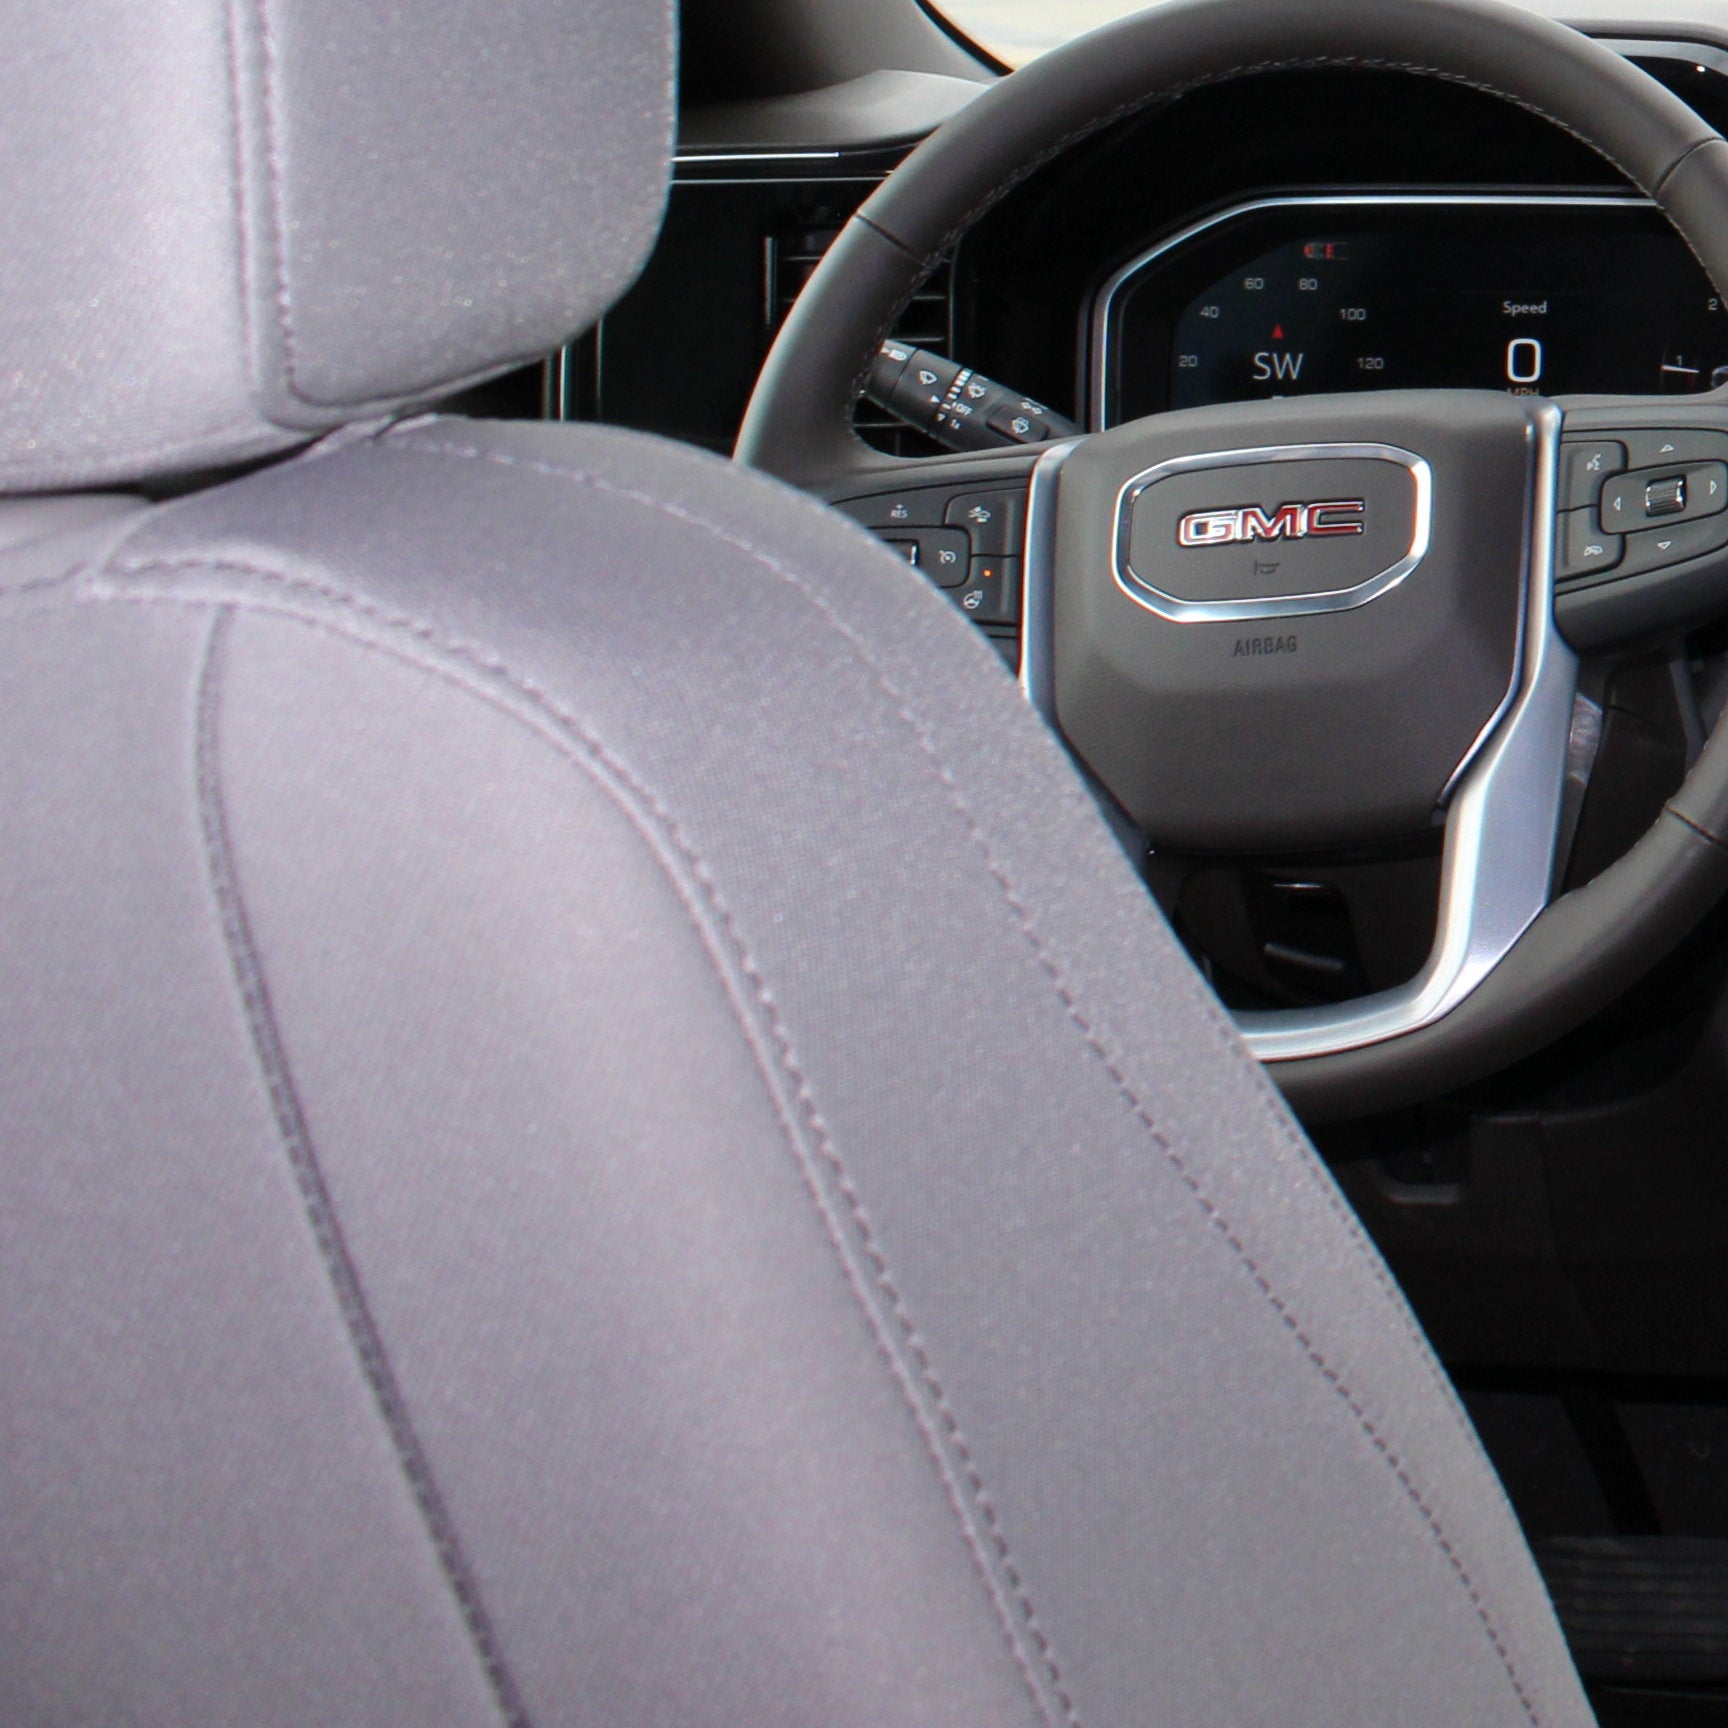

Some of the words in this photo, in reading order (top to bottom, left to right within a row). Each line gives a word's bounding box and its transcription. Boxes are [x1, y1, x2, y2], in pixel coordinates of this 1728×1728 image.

[1243, 278, 1264, 290] 60
[1300, 278, 1318, 290] 80
[1503, 301, 1547, 315] Speed
[1708, 299, 1718, 310] 2
[1200, 306, 1220, 318] 40
[1340, 308, 1366, 320] 100
[1179, 355, 1198, 367] 20
[1252, 352, 1304, 380] SW
[1358, 358, 1384, 370] 120
[1506, 338, 1541, 382] 0
[956, 404, 973, 416] OFF
[891, 508, 908, 518] RES
[1177, 497, 1366, 548] GMC
[1234, 636, 1298, 657] AIRBAG
